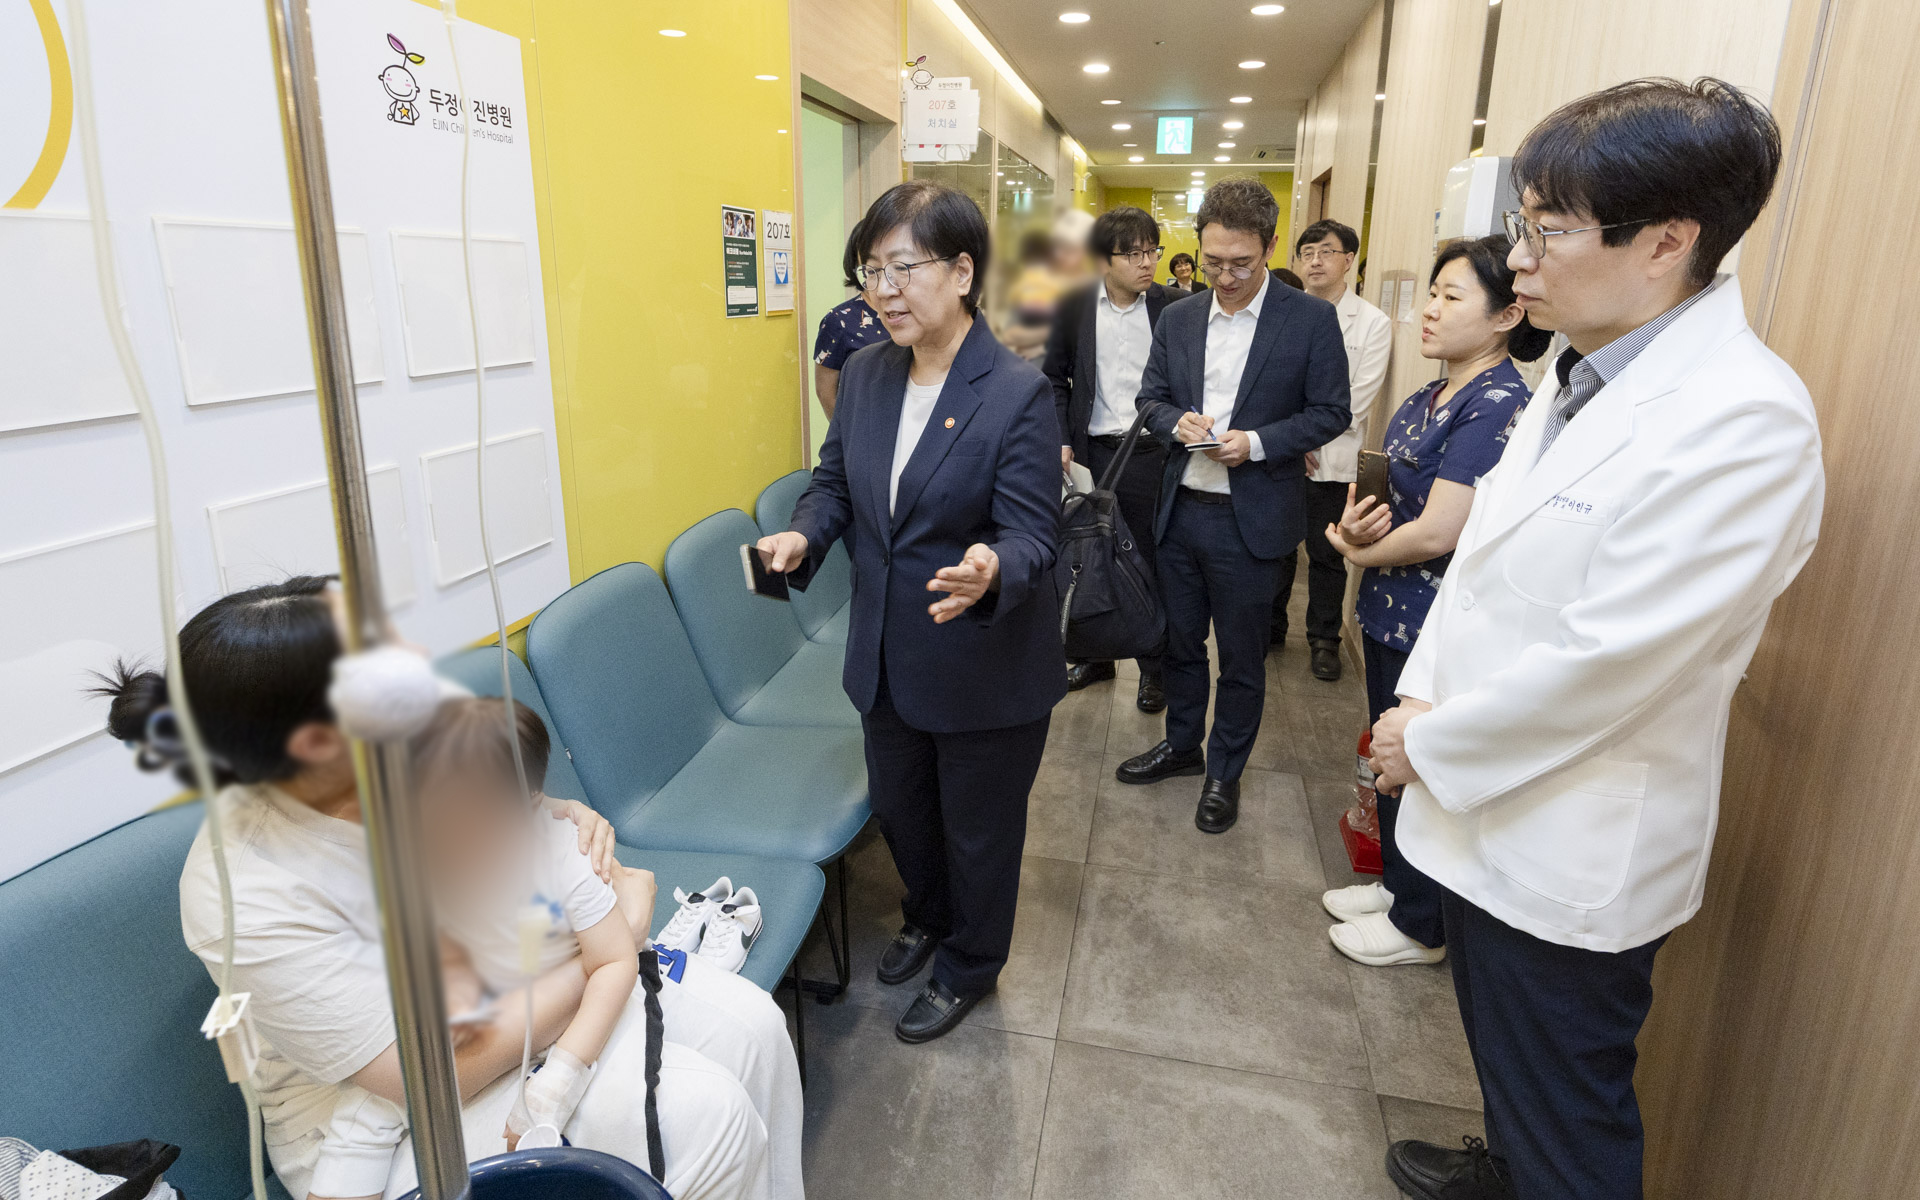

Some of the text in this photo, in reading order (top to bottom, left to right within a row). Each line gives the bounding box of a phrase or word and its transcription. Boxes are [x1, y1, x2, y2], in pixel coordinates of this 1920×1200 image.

[928, 100, 957, 110] 207호
[432, 118, 514, 144] EJIN Chilen's Hospital
[928, 118, 957, 129] 처치실
[766, 221, 791, 240] 207호
